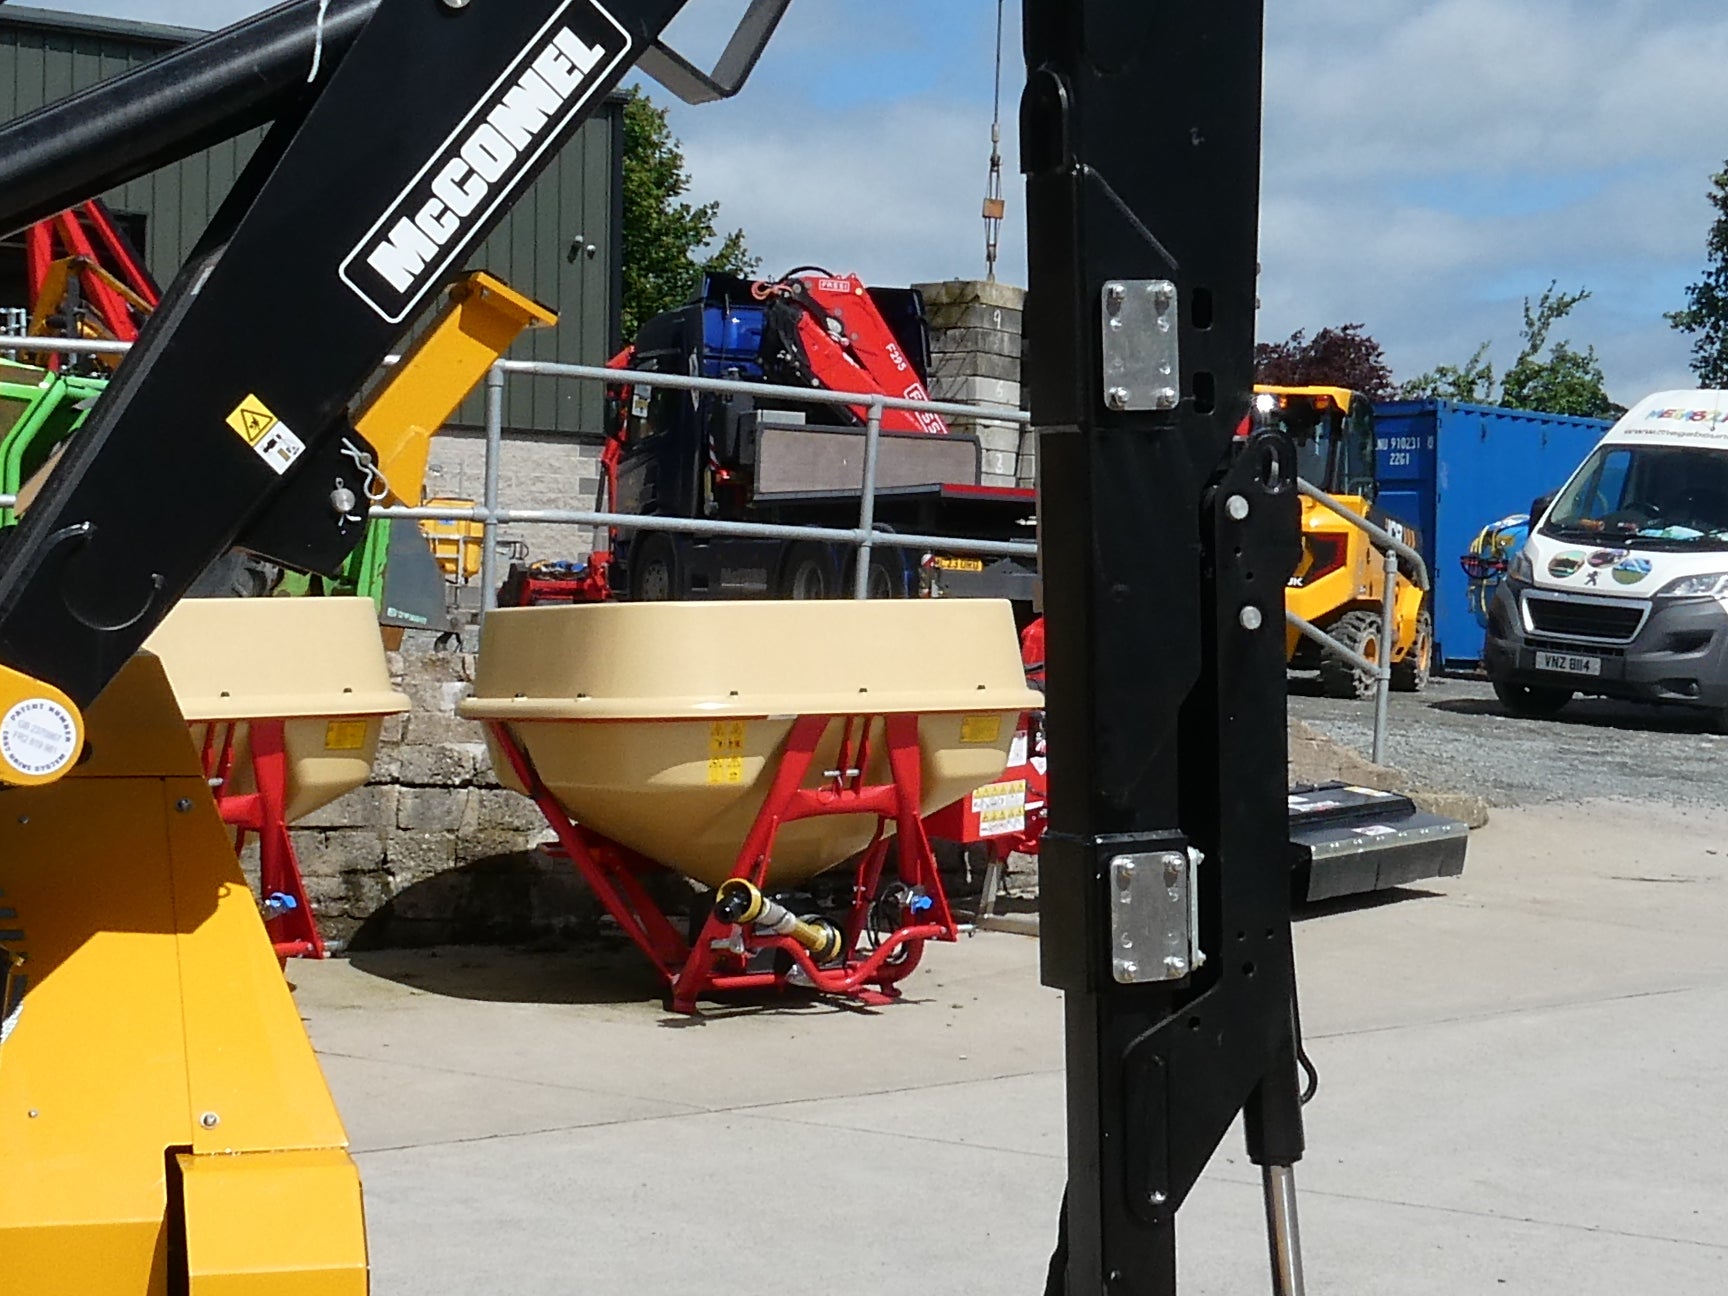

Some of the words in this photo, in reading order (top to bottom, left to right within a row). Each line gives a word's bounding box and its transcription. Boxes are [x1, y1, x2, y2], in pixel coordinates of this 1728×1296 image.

[885, 342, 907, 372] F295
[1544, 654, 1567, 669] VNZ
[1569, 657, 1591, 672] 8114
